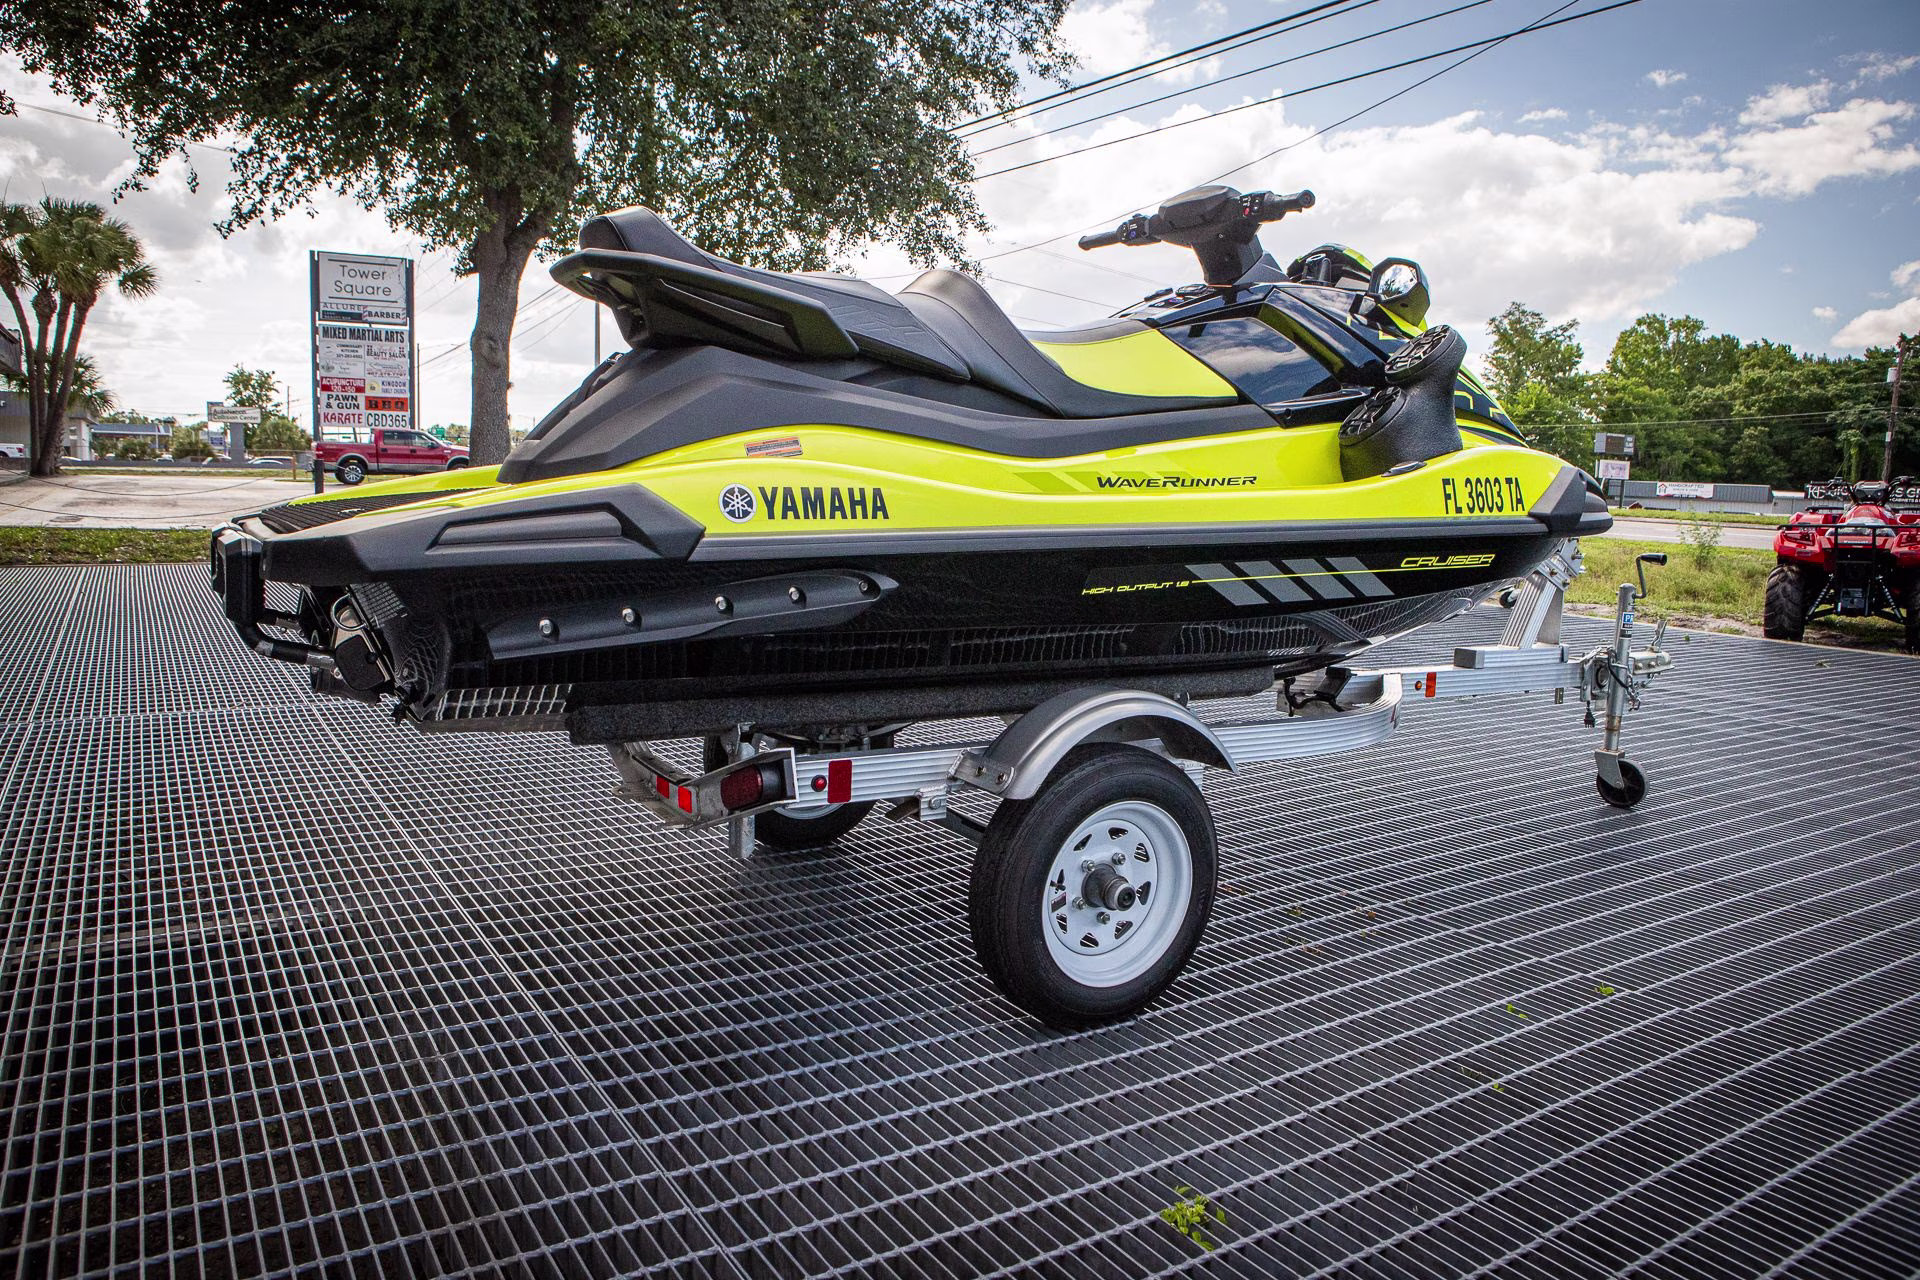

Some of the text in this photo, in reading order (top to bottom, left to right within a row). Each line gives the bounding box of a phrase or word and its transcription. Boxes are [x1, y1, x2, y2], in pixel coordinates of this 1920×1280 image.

[339, 265, 387, 280] Tower
[334, 280, 392, 296] Square
[322, 303, 361, 311] ALLURE
[367, 311, 401, 319] BARBER
[322, 326, 405, 343] MIXED MARTIAL ARTS
[366, 350, 388, 358] BEAUTY
[388, 351, 406, 359] SALON
[322, 378, 364, 387] ACUPUNCTURE
[325, 401, 360, 410] & GUN
[327, 394, 358, 402] PAWN
[323, 412, 363, 425] KARATE
[366, 413, 407, 428] CBD365
[758, 486, 890, 520] YAMAHA
[1441, 477, 1526, 515] FL 3603 TA
[1400, 553, 1496, 568] CRUISER
[1081, 586, 1114, 596] HIGH
[1116, 581, 1174, 593] OUTPUT
